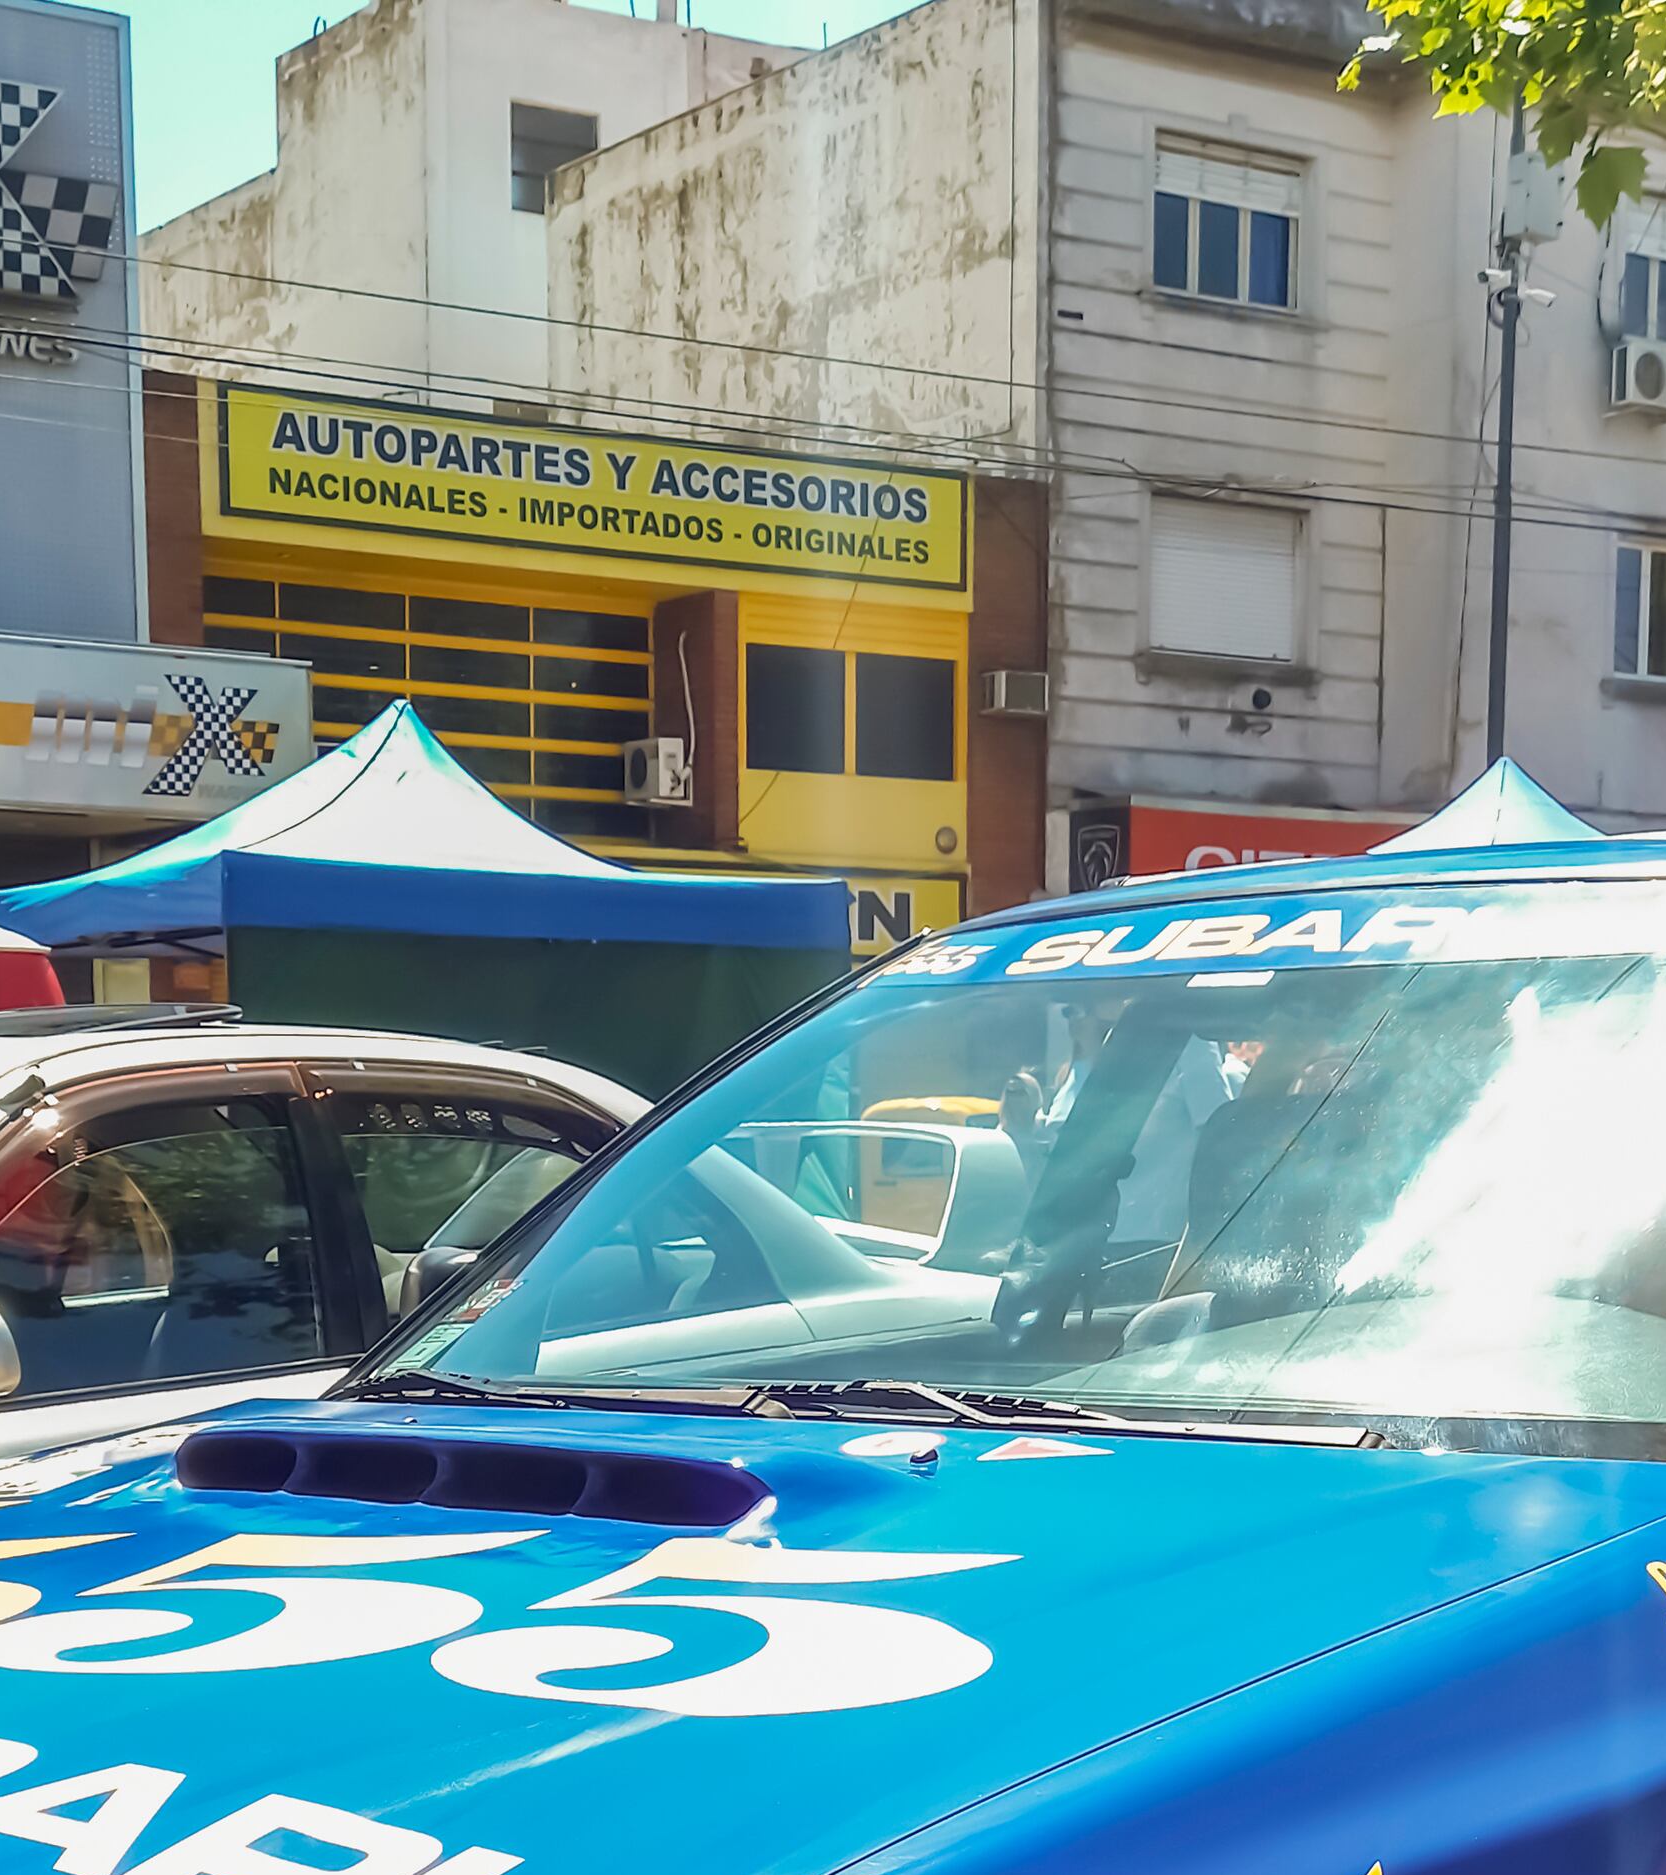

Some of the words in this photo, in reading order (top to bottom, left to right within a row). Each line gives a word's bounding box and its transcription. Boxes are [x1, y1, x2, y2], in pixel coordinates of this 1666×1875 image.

[268, 466, 489, 518] NACIONALES
[519, 496, 724, 544] IMPORTADOS
[751, 522, 930, 565] ORIGINALES
[272, 412, 591, 486] AUTOPARTES
[606, 452, 637, 491] Y
[650, 458, 929, 524] ACCESORIOS
